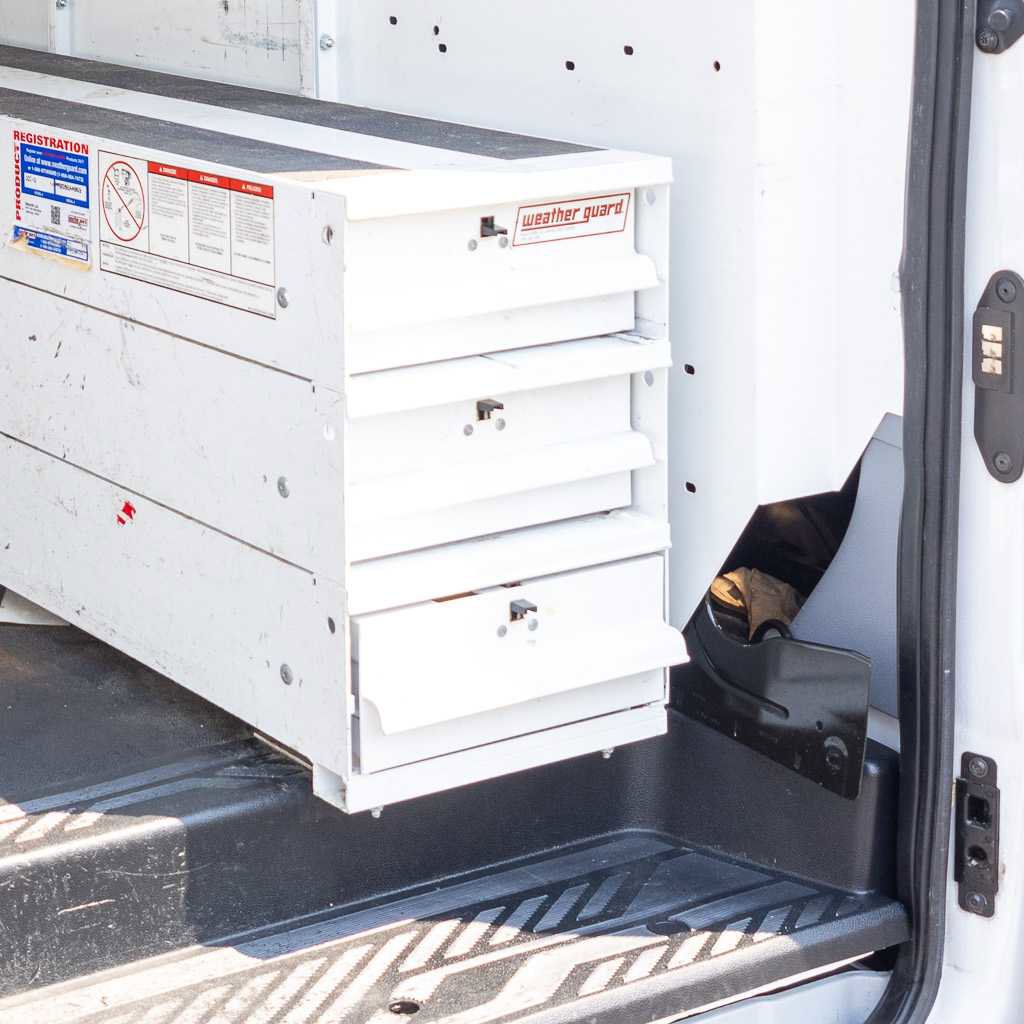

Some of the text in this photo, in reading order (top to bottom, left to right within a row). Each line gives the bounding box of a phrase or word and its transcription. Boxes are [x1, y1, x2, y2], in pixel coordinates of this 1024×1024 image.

[13, 130, 89, 155] REGISTRATION
[522, 199, 624, 227] weather guard
